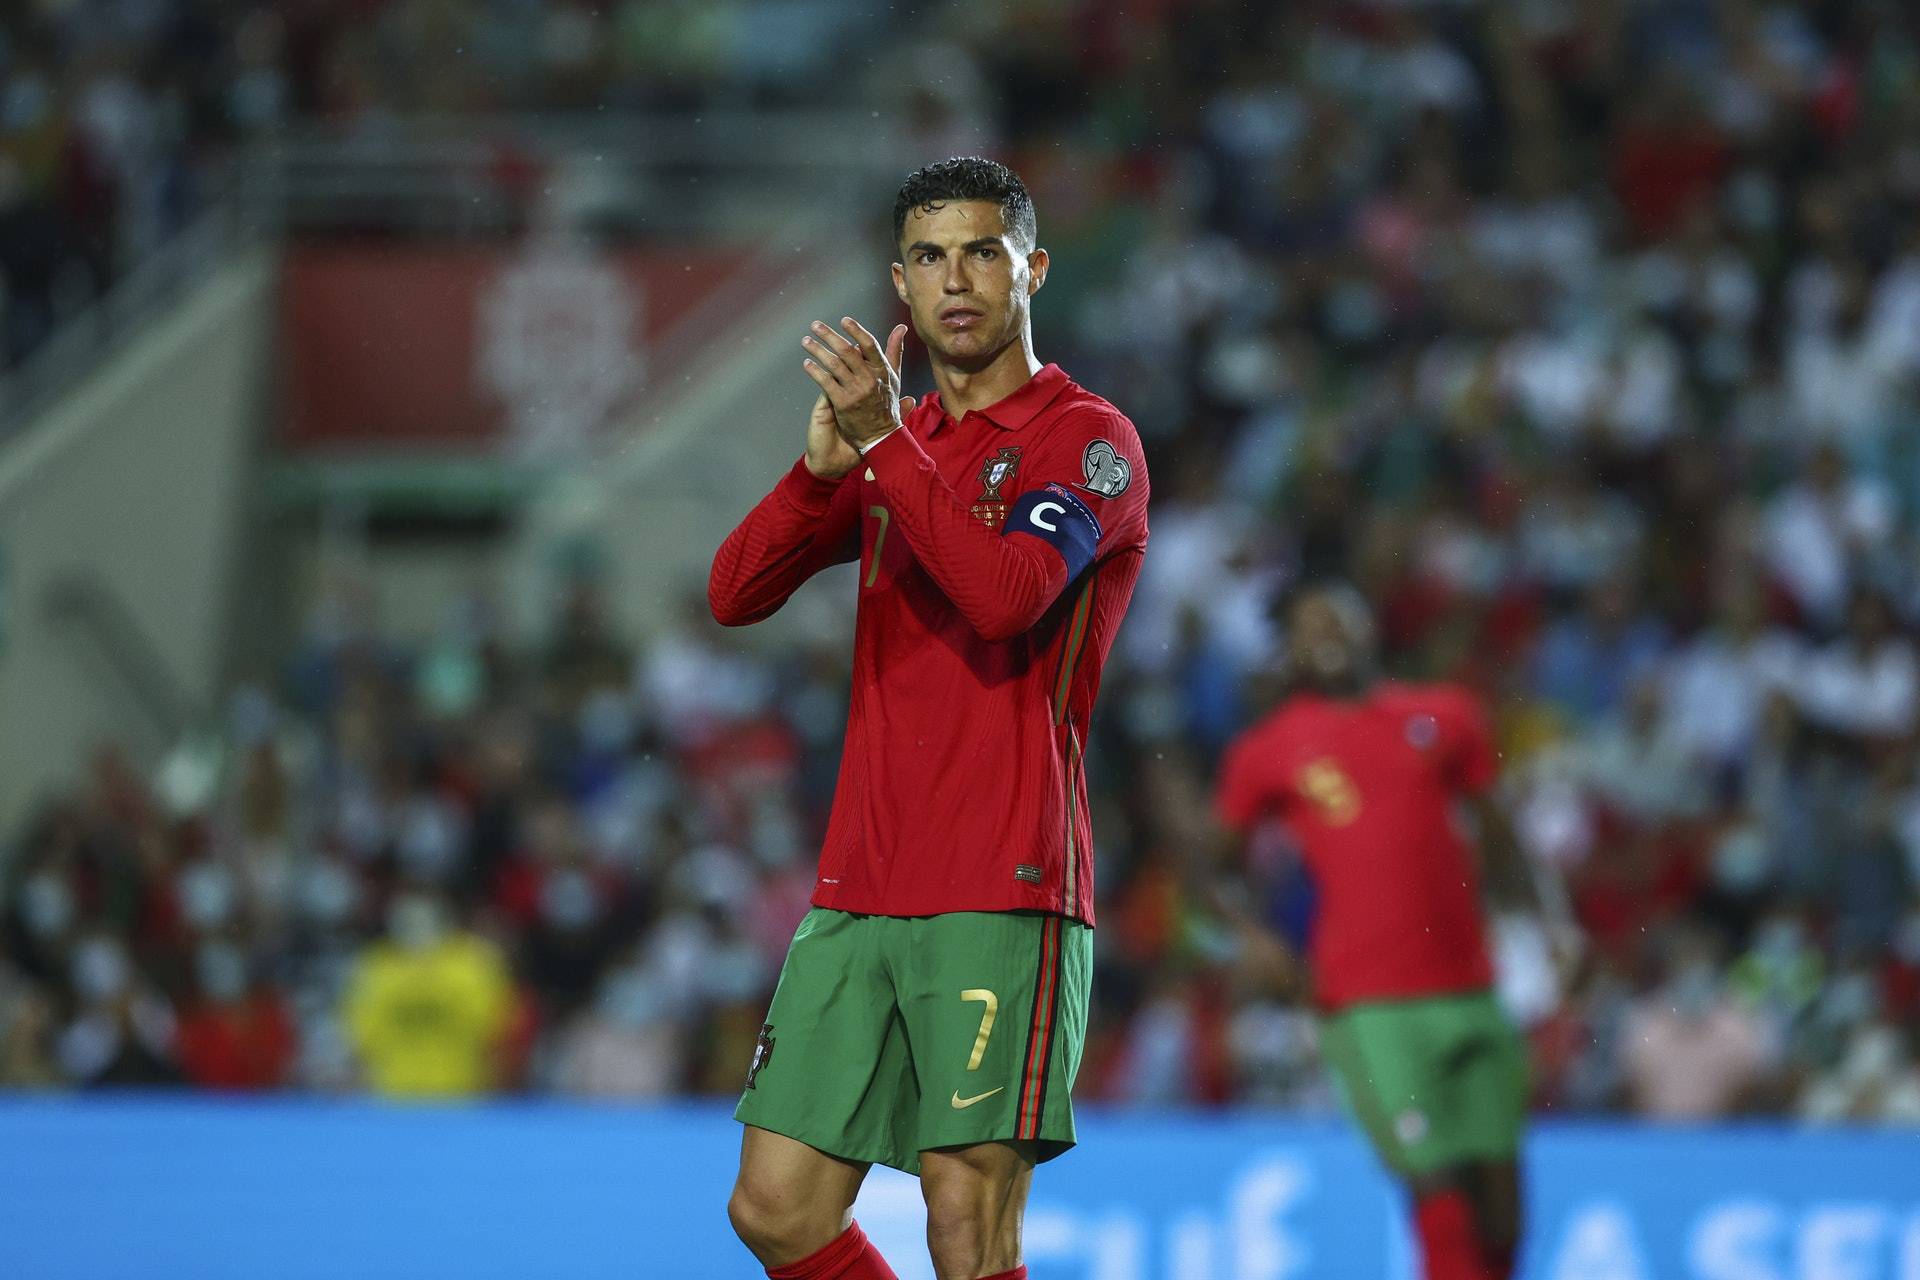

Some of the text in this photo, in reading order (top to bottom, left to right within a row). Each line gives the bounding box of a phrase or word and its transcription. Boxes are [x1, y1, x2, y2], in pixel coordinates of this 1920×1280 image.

[865, 505, 889, 588] 7
[1029, 501, 1067, 533] C
[960, 988, 998, 1072] 7
